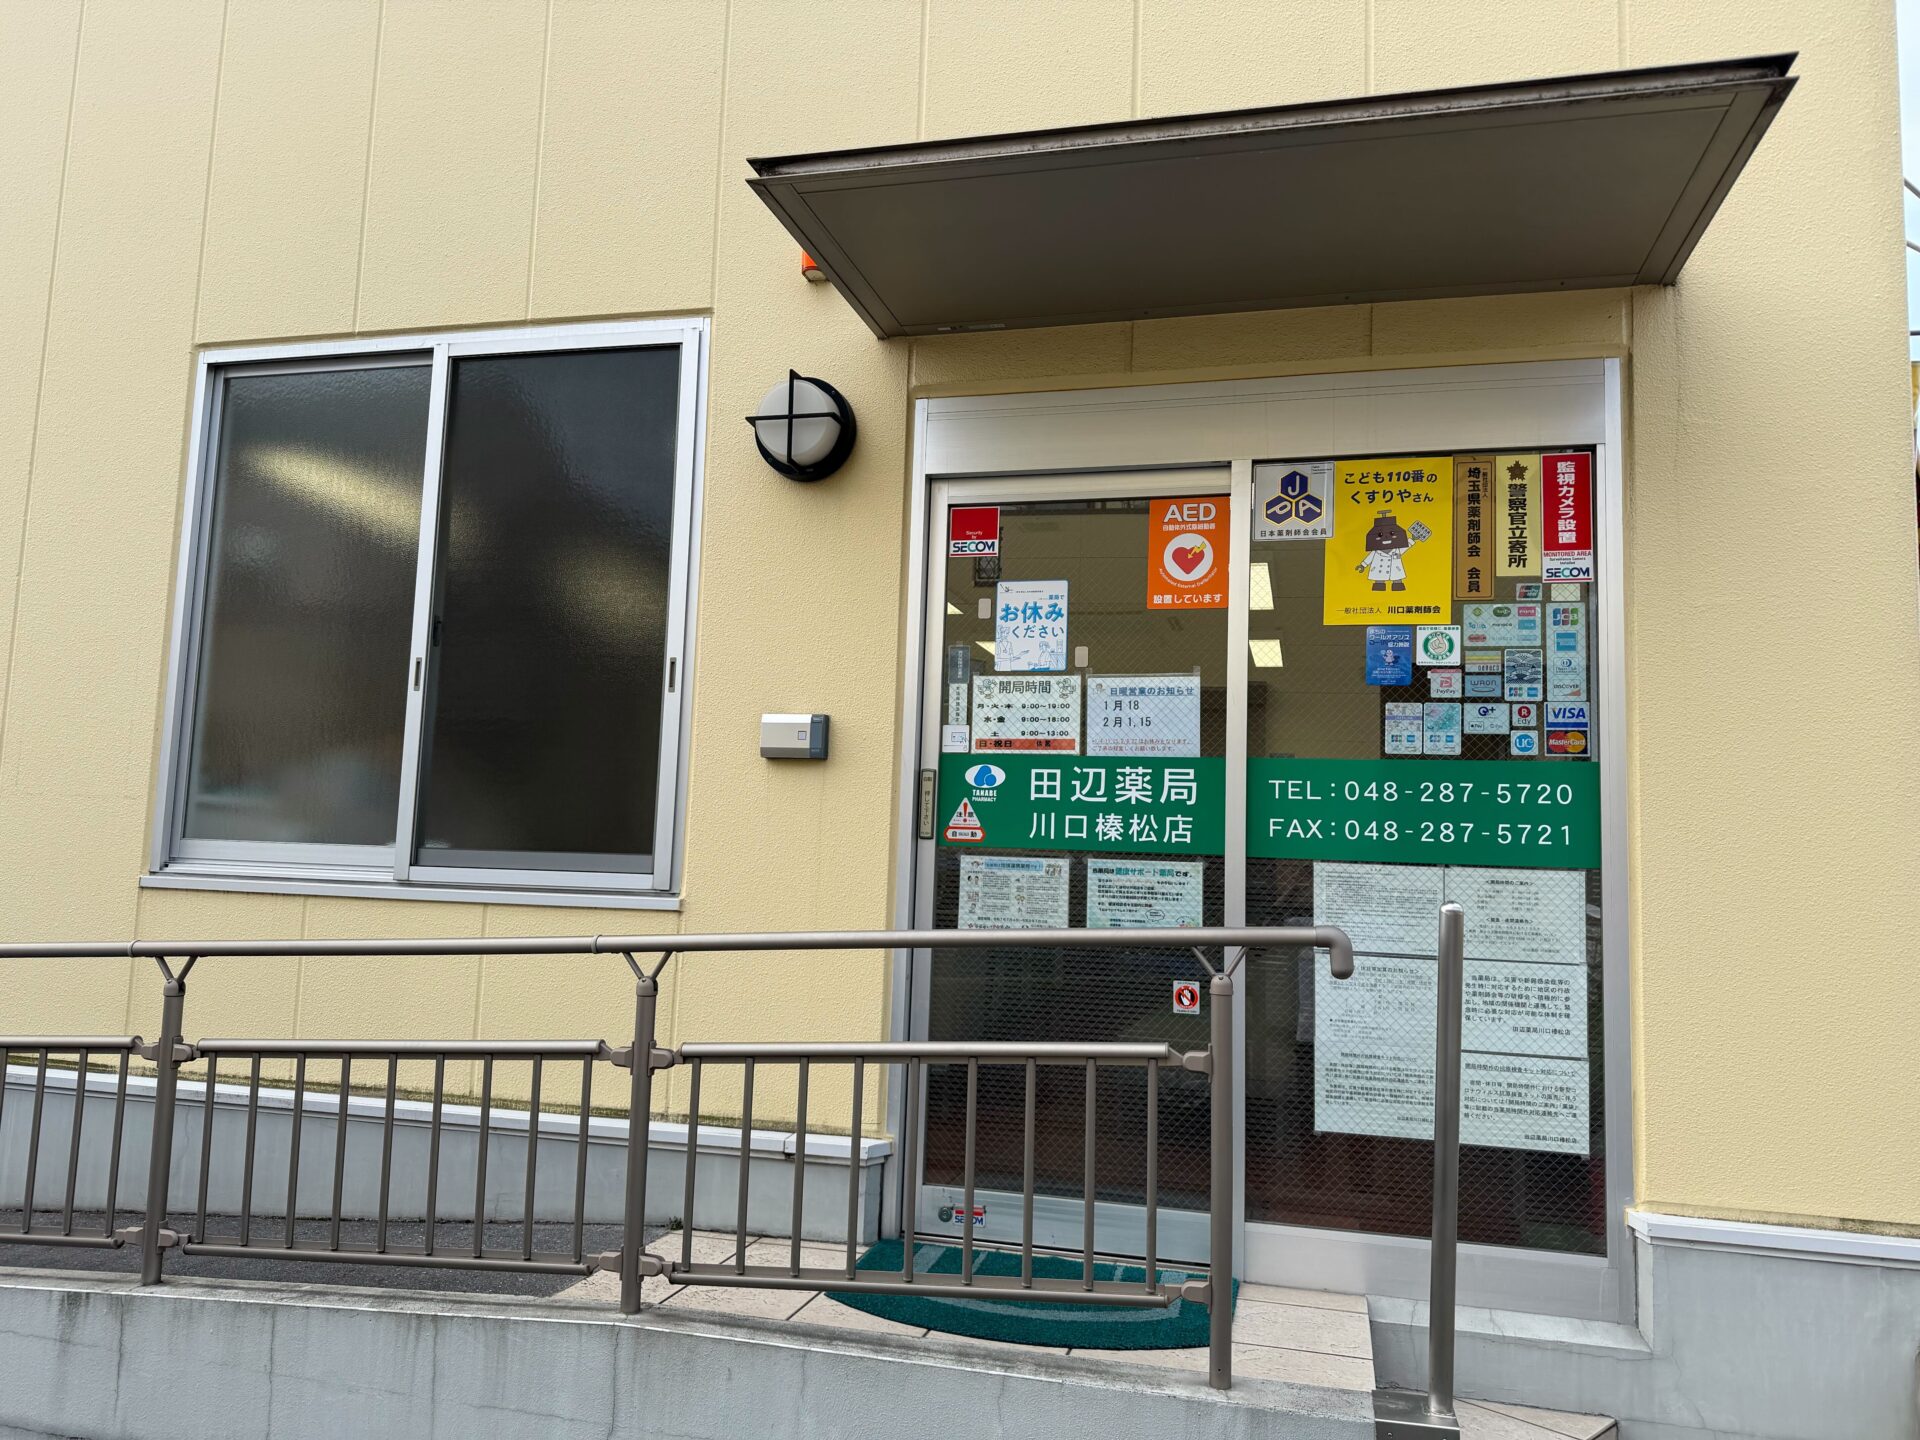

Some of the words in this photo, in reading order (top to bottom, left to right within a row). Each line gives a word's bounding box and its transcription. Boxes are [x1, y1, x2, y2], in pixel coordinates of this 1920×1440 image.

[1344, 470, 1437, 485] こども110番の
[1351, 488, 1433, 504] くすりやさん
[1557, 461, 1577, 544] 監視カメラ設置
[1163, 503, 1217, 522] AED
[1467, 467, 1481, 557] 埼玉県薬剤師会
[1508, 484, 1527, 568] 警察官立寄所
[1260, 528, 1327, 538] 日本薬剤師会会員
[953, 541, 995, 553] SECOM
[1546, 567, 1590, 578] SECOM
[1467, 567, 1481, 593] 会員
[1153, 593, 1222, 604] 設置しています
[1000, 601, 1064, 623] お休み
[1336, 607, 1382, 615] 一般社団法人
[1387, 605, 1441, 615] 川口薬剤師会
[1012, 624, 1064, 639] ください
[998, 680, 1051, 694] 開局時間
[1110, 687, 1194, 696] 日曜営業のお知らせ
[1552, 707, 1586, 719] VISA
[1517, 717, 1531, 725] Edy
[1516, 738, 1534, 748] UC
[1549, 738, 1586, 746] MasterCard
[1030, 766, 1198, 805] 田辺薬局
[972, 789, 997, 797] TANABE
[1029, 812, 1193, 843] 川口榛松店
[955, 1215, 984, 1226] SEOM
